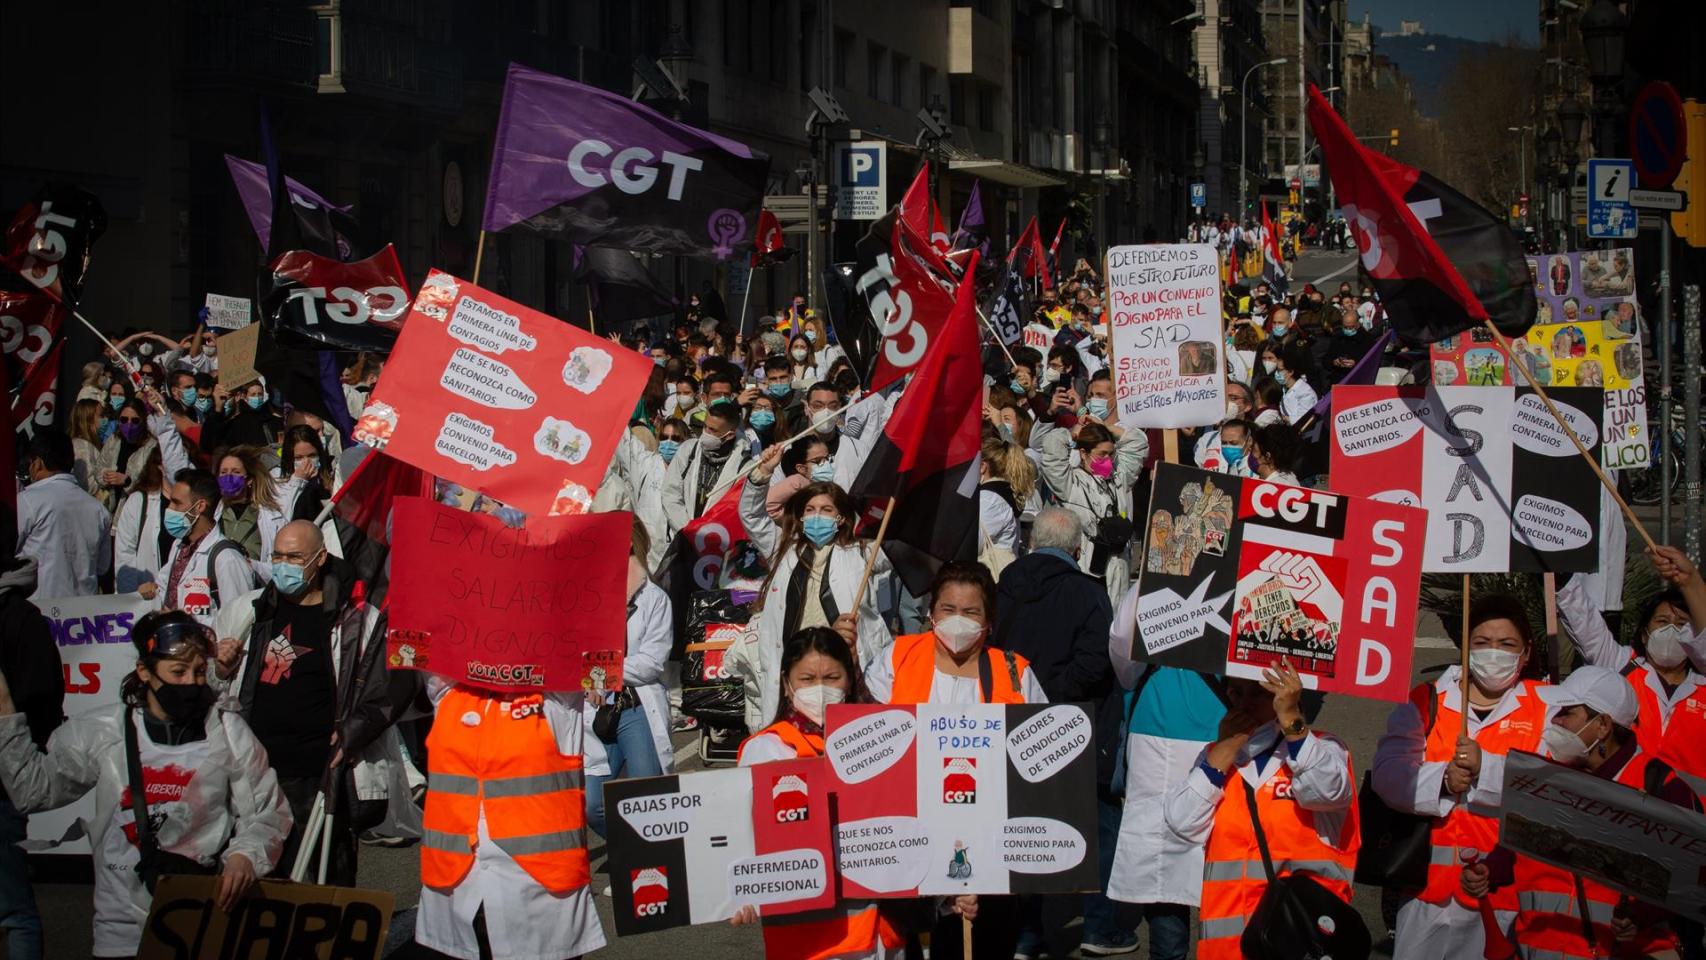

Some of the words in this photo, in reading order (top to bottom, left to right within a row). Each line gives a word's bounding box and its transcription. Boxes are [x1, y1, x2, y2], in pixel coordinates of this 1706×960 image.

[567, 139, 704, 202] CGT
[848, 153, 872, 183] P
[1110, 249, 1199, 268] DEFENDEMOS
[1111, 268, 1171, 288] NUESTRO
[1172, 264, 1216, 282] FUTURO
[1111, 291, 1139, 308] POR
[1142, 289, 1156, 303] UN
[1157, 286, 1214, 303] CONVENIO
[462, 298, 503, 322] ESTAMOS
[504, 317, 517, 327] EN
[1114, 310, 1156, 327] DIGNO
[1155, 307, 1183, 322] PARA
[1187, 302, 1207, 317] EL
[450, 325, 501, 350] CONTAGIOS
[456, 312, 495, 334] PRIMERA
[520, 338, 533, 349] DE
[1134, 323, 1191, 350] SAD
[456, 349, 477, 364] QUE
[478, 356, 488, 370] SE
[490, 363, 510, 377] NOS
[1118, 357, 1170, 370] SERVICIO
[449, 362, 504, 394] RECONOZCA
[505, 384, 535, 405] COMO
[1117, 377, 1200, 400] DEPENDENCIA
[1206, 377, 1214, 385] A
[1118, 370, 1171, 384] ATENCION
[442, 375, 498, 406] SANITARIOS.
[1125, 395, 1171, 414] NUESTROS
[1173, 389, 1218, 404] MAYORES
[1619, 386, 1646, 408] LOS
[1337, 409, 1358, 425] QUE
[1360, 406, 1372, 420] SE
[1373, 401, 1394, 415] NOS
[1341, 416, 1399, 439] RECONOZCA
[1400, 407, 1430, 426] COMO
[1564, 414, 1576, 423] EN
[1612, 407, 1636, 426] UN
[449, 414, 492, 437] EXIGIMOS
[1513, 424, 1561, 447] CONTAGIOS
[1517, 411, 1555, 430] PRIMERA
[1556, 426, 1578, 437] LINA
[1580, 434, 1592, 444] DE
[437, 439, 488, 468] BARCELONA
[443, 426, 489, 450] CONVENIO
[489, 444, 513, 462] PARA
[1251, 483, 1338, 529] CGT
[1522, 497, 1567, 519] EXIGIMOS
[429, 512, 598, 560] EXIGIMOS
[1515, 525, 1565, 547] BARCELONA
[1518, 510, 1564, 533] CONVENIO
[1565, 524, 1588, 540] PARA
[693, 522, 730, 590] CG
[448, 567, 603, 614] SALARIOS
[1264, 590, 1283, 604] TENER
[184, 605, 209, 615] CGT
[1138, 600, 1182, 623] EXIGIMOS
[1142, 615, 1190, 638] CONVENIO
[1190, 604, 1214, 620] PARA
[1254, 600, 1291, 620] DERECHOS
[1147, 626, 1200, 651] BARCELONA
[467, 662, 497, 676] VOTA
[498, 664, 533, 681] CGT
[704, 665, 730, 680] CG
[511, 703, 542, 720] CGT
[930, 715, 977, 730] ABUSO
[984, 719, 1001, 730] DE
[833, 725, 874, 751] ESTAMOS
[873, 718, 887, 735] EN
[1010, 712, 1055, 747] MEJORES
[1019, 714, 1085, 763] CONDICIONES
[840, 740, 878, 763] PRIMERA
[900, 720, 914, 734] DE
[846, 746, 894, 777] CONTAGIOS
[1028, 761, 1043, 777] DE
[1042, 734, 1087, 768] TRABAJO
[622, 799, 667, 815] BAJAS
[671, 795, 702, 809] POR
[944, 791, 974, 803] CGT
[776, 807, 808, 822] CGT
[642, 821, 689, 838] COVID
[838, 829, 859, 841] QUE
[861, 828, 871, 838] SE
[874, 825, 894, 836] NOS
[1003, 825, 1047, 834] EXIGIMOS
[839, 840, 897, 855] RECONOZCA
[899, 836, 929, 847] COMO
[1003, 840, 1050, 849] CONVENIO
[1052, 840, 1076, 848] PARA
[733, 858, 819, 876] ENFERMEDAD
[840, 855, 900, 870] SANITARIOS.
[1003, 854, 1056, 862] BARCELONA
[735, 877, 819, 896] PROFESIONAL
[636, 902, 668, 917] CGT
